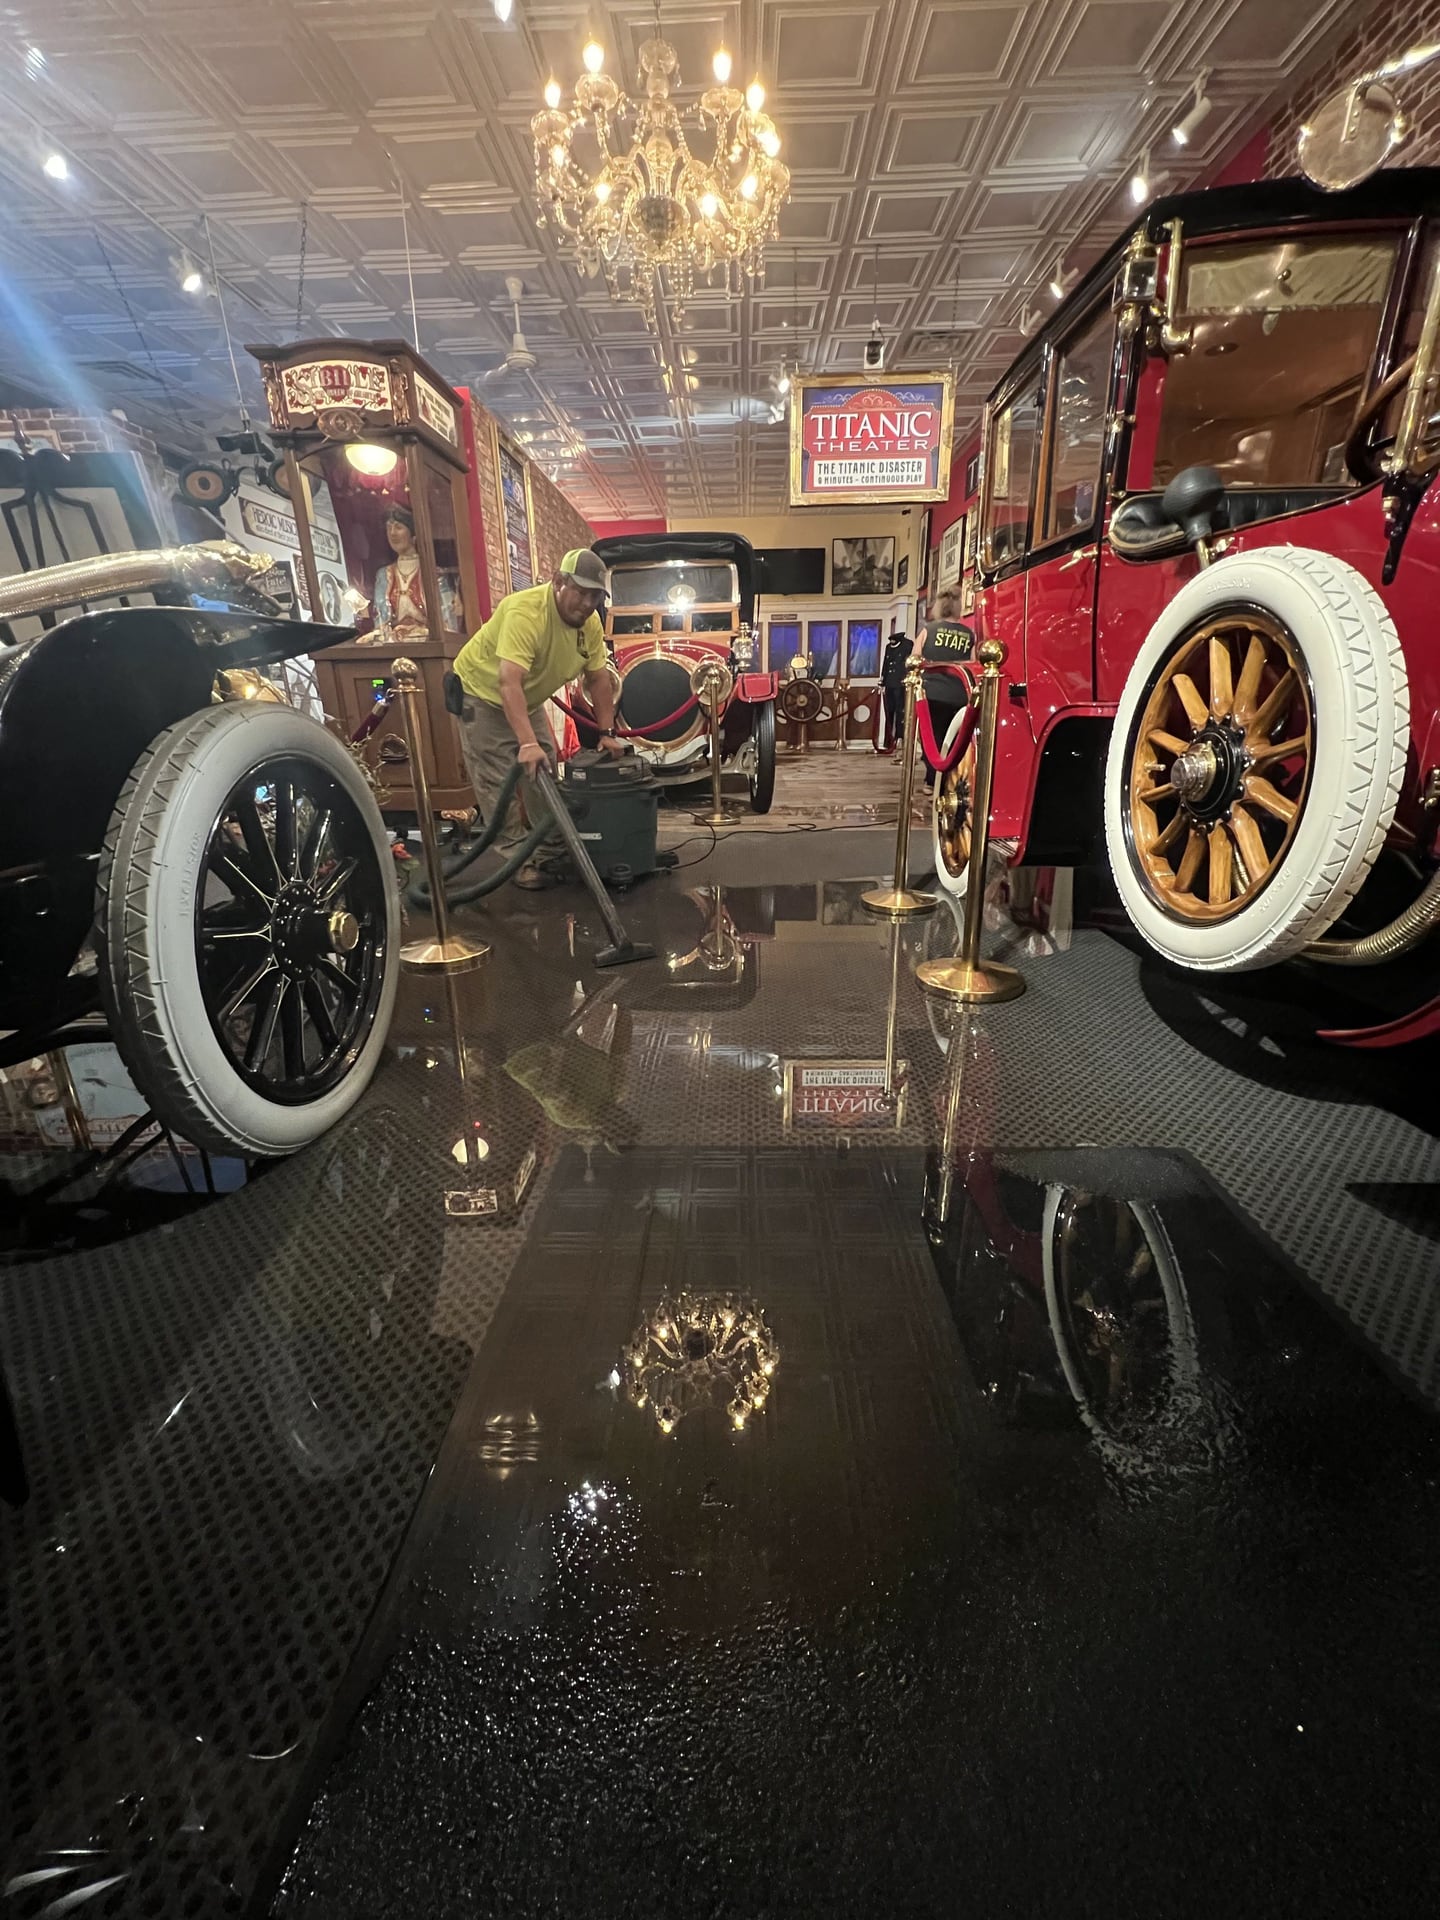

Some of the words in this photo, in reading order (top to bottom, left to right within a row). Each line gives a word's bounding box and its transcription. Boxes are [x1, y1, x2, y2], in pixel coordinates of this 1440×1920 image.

[810, 411, 932, 440] TITANIC
[812, 439, 928, 453] THEATER
[818, 462, 835, 475] THE
[838, 461, 876, 475] TITANIC
[879, 460, 922, 473] DISASTER
[824, 475, 853, 485] MINUTES
[861, 474, 904, 484] CONTINUOUS
[906, 473, 922, 483] PLAY
[935, 633, 970, 653] STAFF
